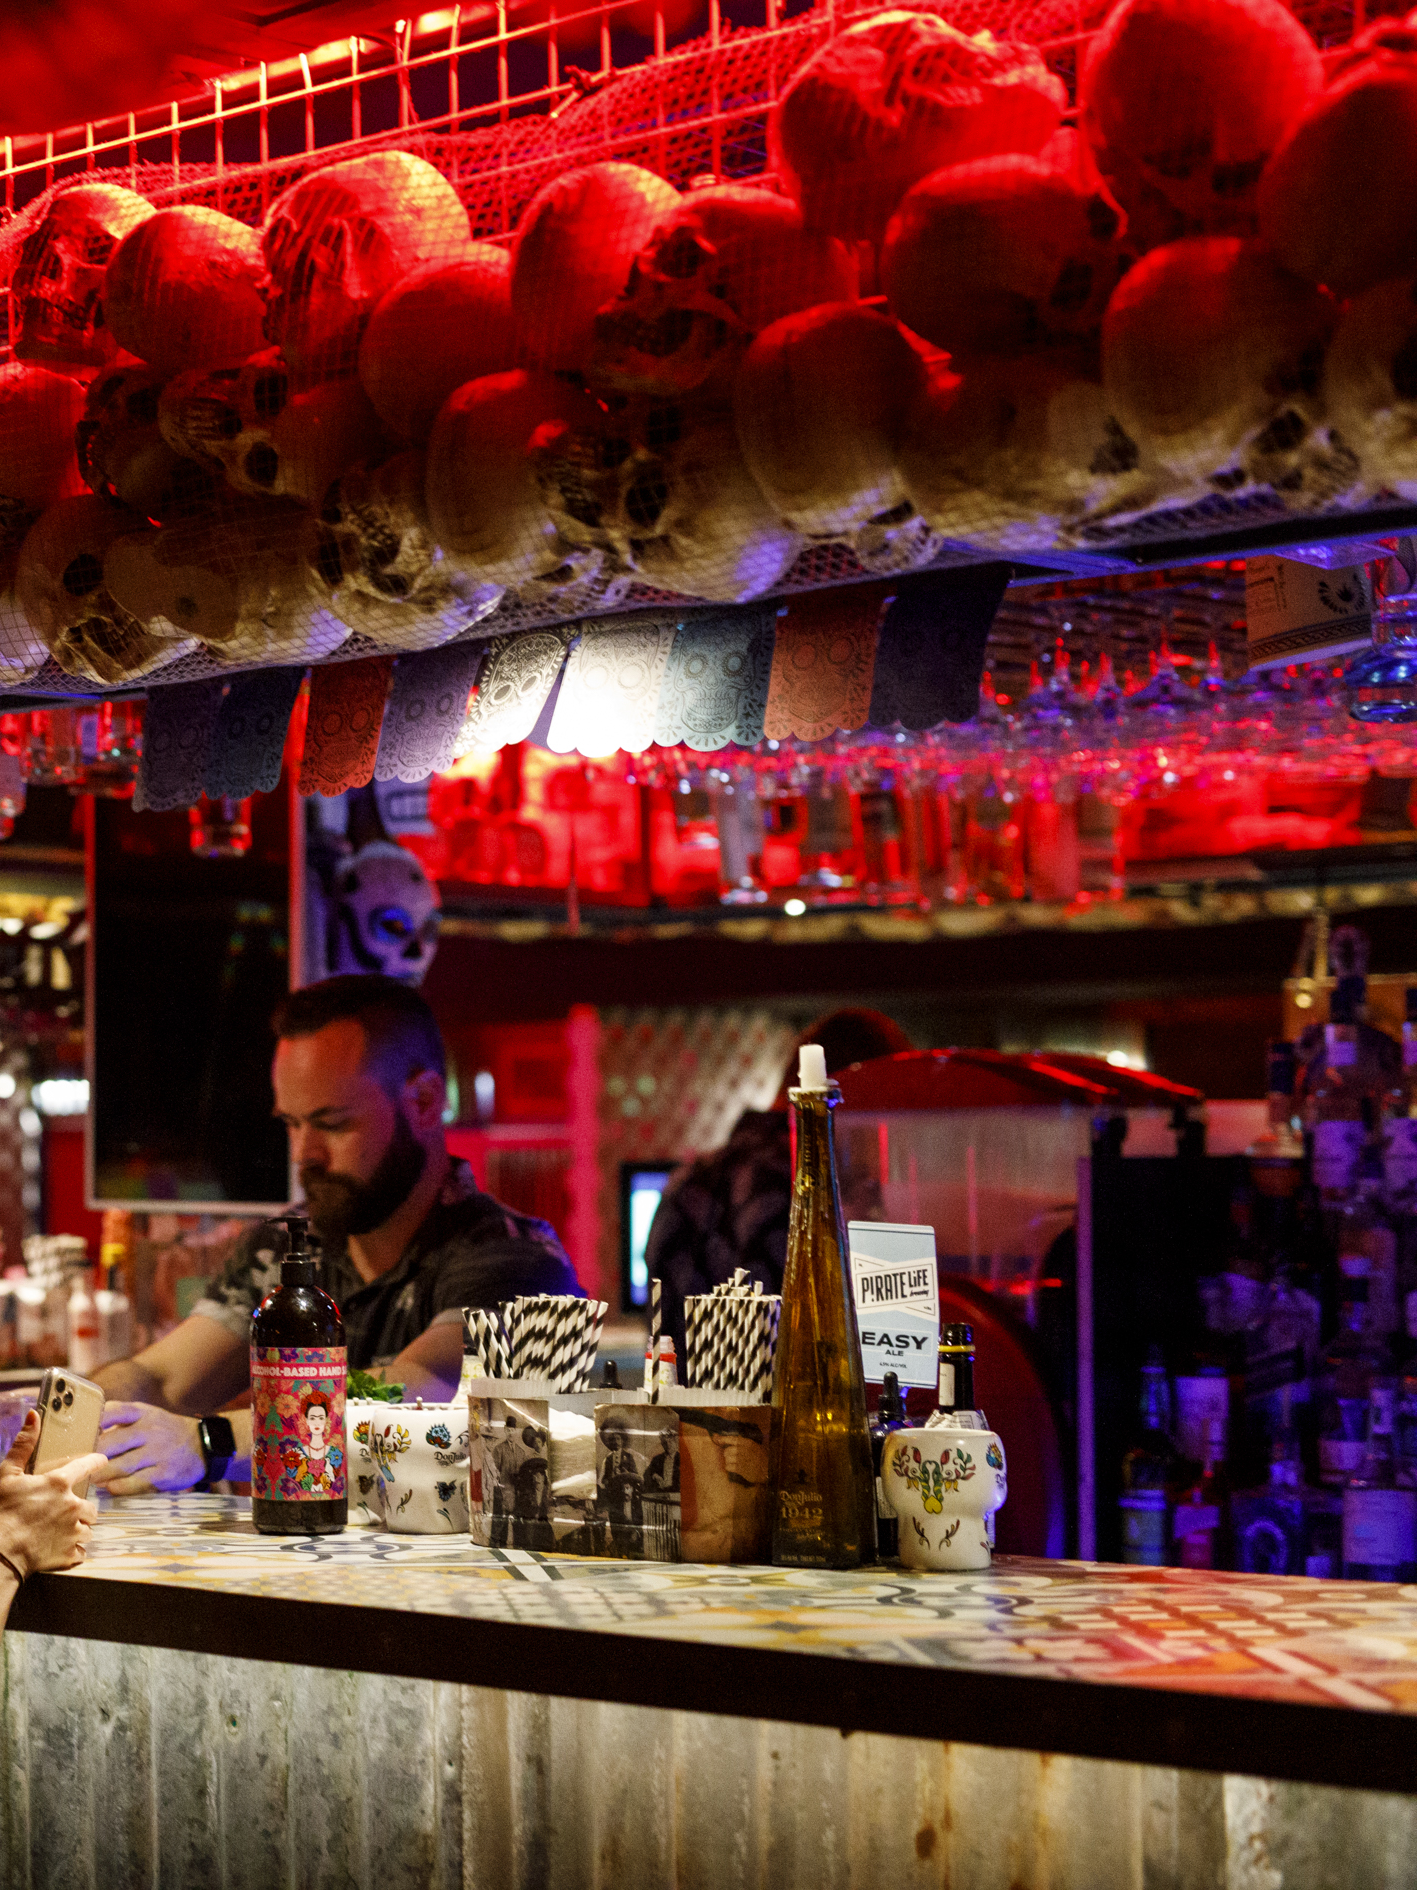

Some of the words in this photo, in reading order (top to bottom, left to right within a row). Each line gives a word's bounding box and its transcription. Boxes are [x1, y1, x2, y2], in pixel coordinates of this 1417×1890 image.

[861, 1331, 929, 1350] EASY
[885, 1349, 904, 1357] ALE
[319, 1366, 341, 1377] HAND
[781, 1506, 824, 1519] 1942
